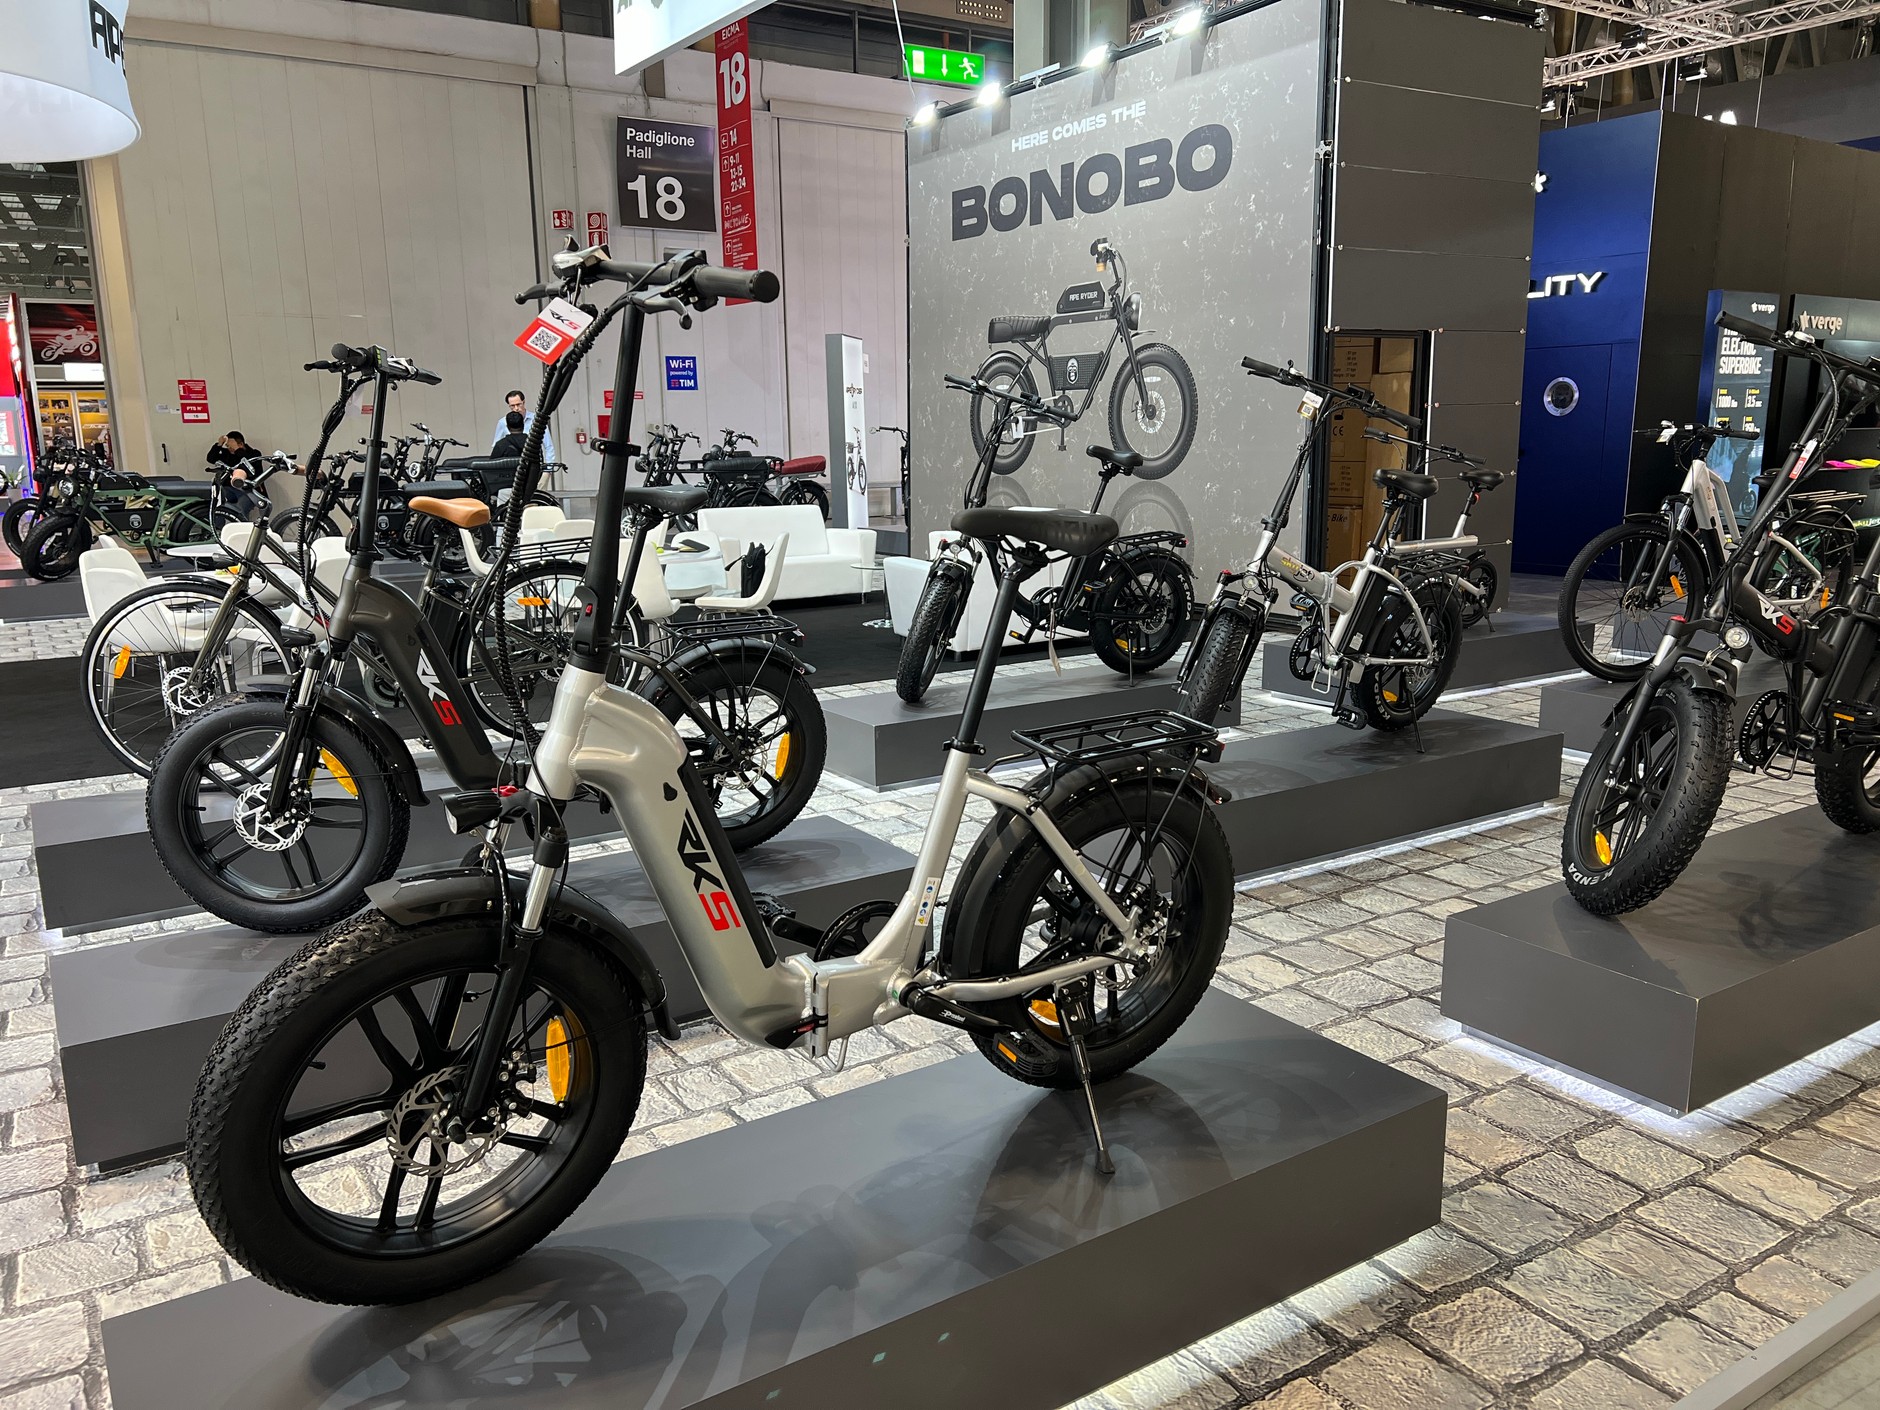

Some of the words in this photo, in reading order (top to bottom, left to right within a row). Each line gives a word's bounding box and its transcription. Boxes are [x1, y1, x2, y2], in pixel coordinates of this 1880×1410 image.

[721, 22, 740, 40] EICMA
[719, 52, 747, 109] 18
[1011, 130, 1049, 152] HERE
[1052, 113, 1107, 141] COMES
[1111, 100, 1147, 124] THE
[626, 127, 696, 148] Padiglione
[729, 128, 737, 146] 14
[626, 144, 652, 159] Hall
[729, 152, 740, 167] 9-11
[730, 164, 743, 179] 13-15
[730, 176, 746, 193] 22-24
[952, 123, 1233, 241] BONOBO
[627, 174, 686, 222] 18
[1758, 303, 1776, 314] verge
[1811, 315, 1843, 335] verge
[669, 360, 694, 369] Wi-Fi
[1719, 356, 1763, 375] SUPERBIKE
[679, 379, 695, 387] TIM
[1177, 574, 1192, 620] KENDA
[1757, 593, 1797, 635] RKS
[416, 648, 462, 726] RKS
[677, 808, 742, 931] RKS
[1567, 863, 1616, 886] KENDA
